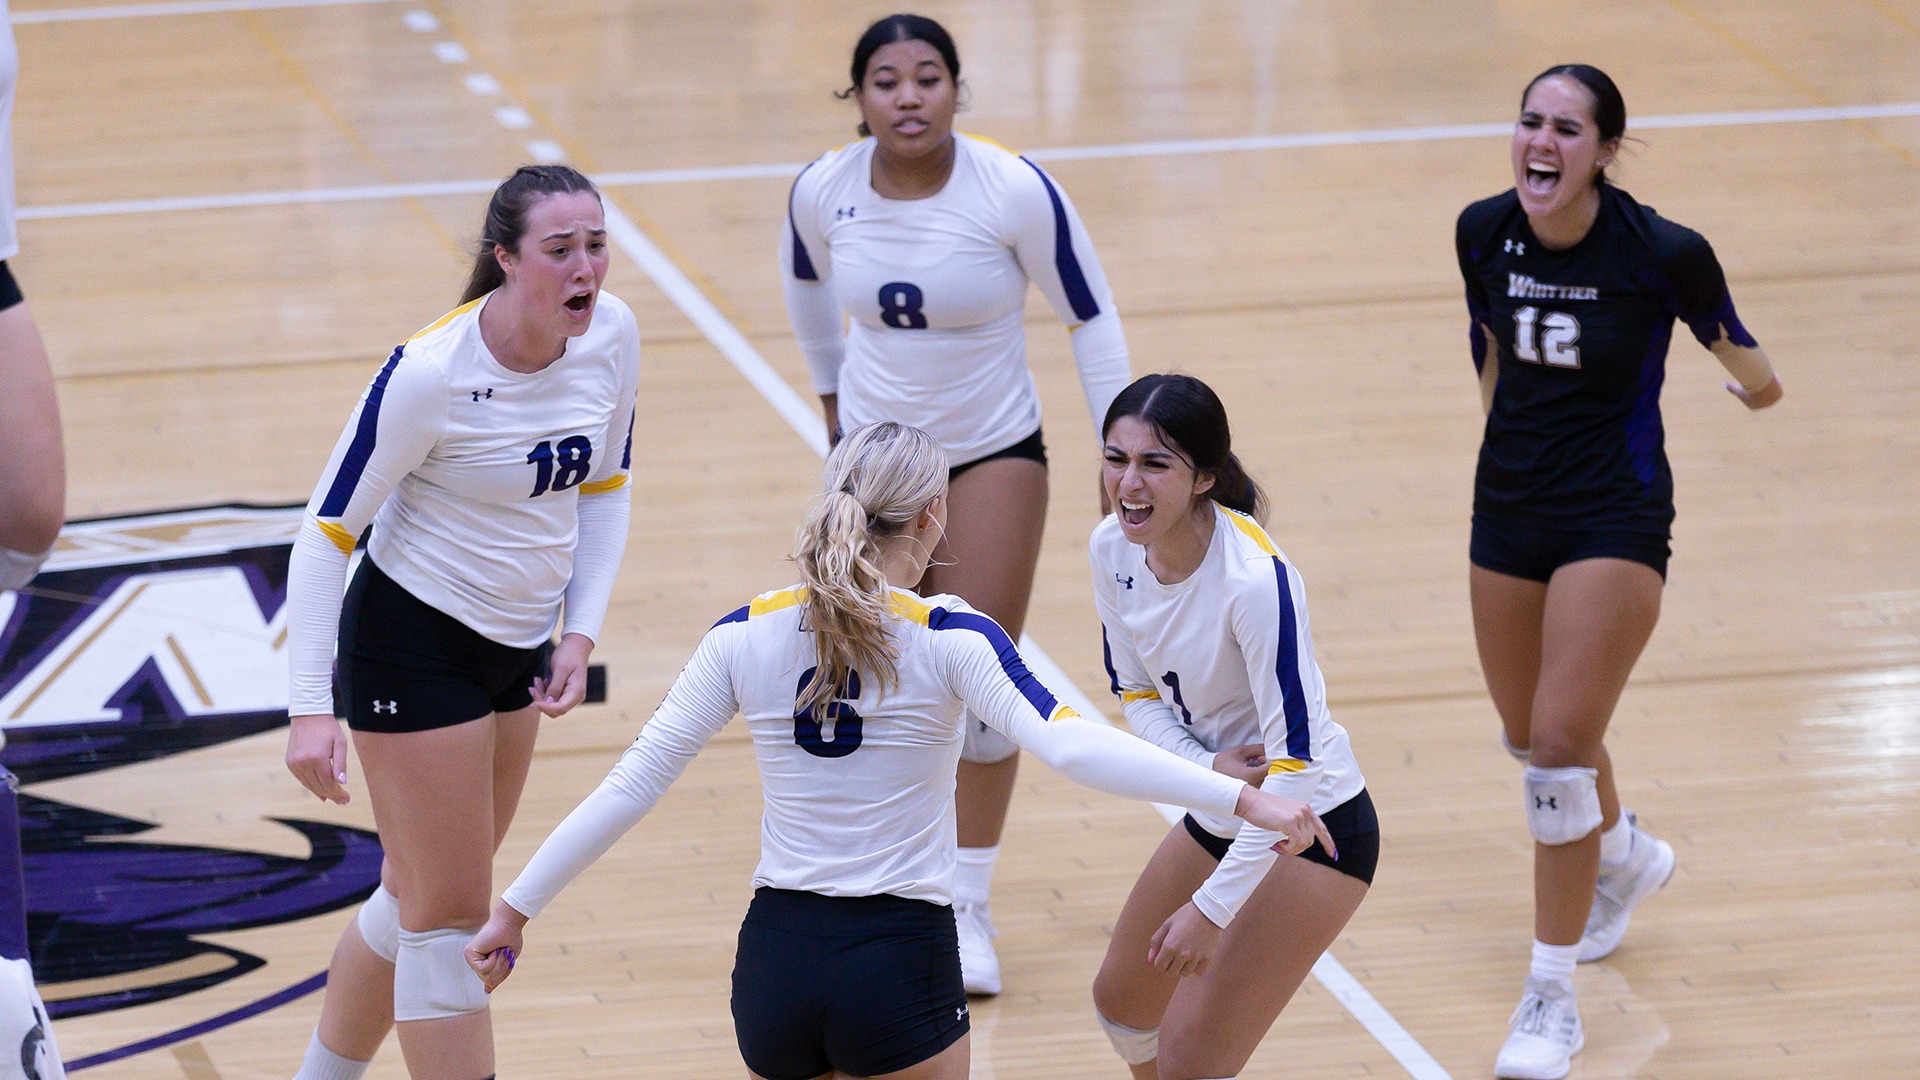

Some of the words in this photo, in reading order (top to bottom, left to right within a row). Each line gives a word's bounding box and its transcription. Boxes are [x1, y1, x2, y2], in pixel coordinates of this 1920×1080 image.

[878, 282, 927, 329] 8
[1512, 305, 1581, 369] 12
[526, 435, 593, 498] 18
[794, 664, 863, 758] 6
[1161, 670, 1193, 725] 1
